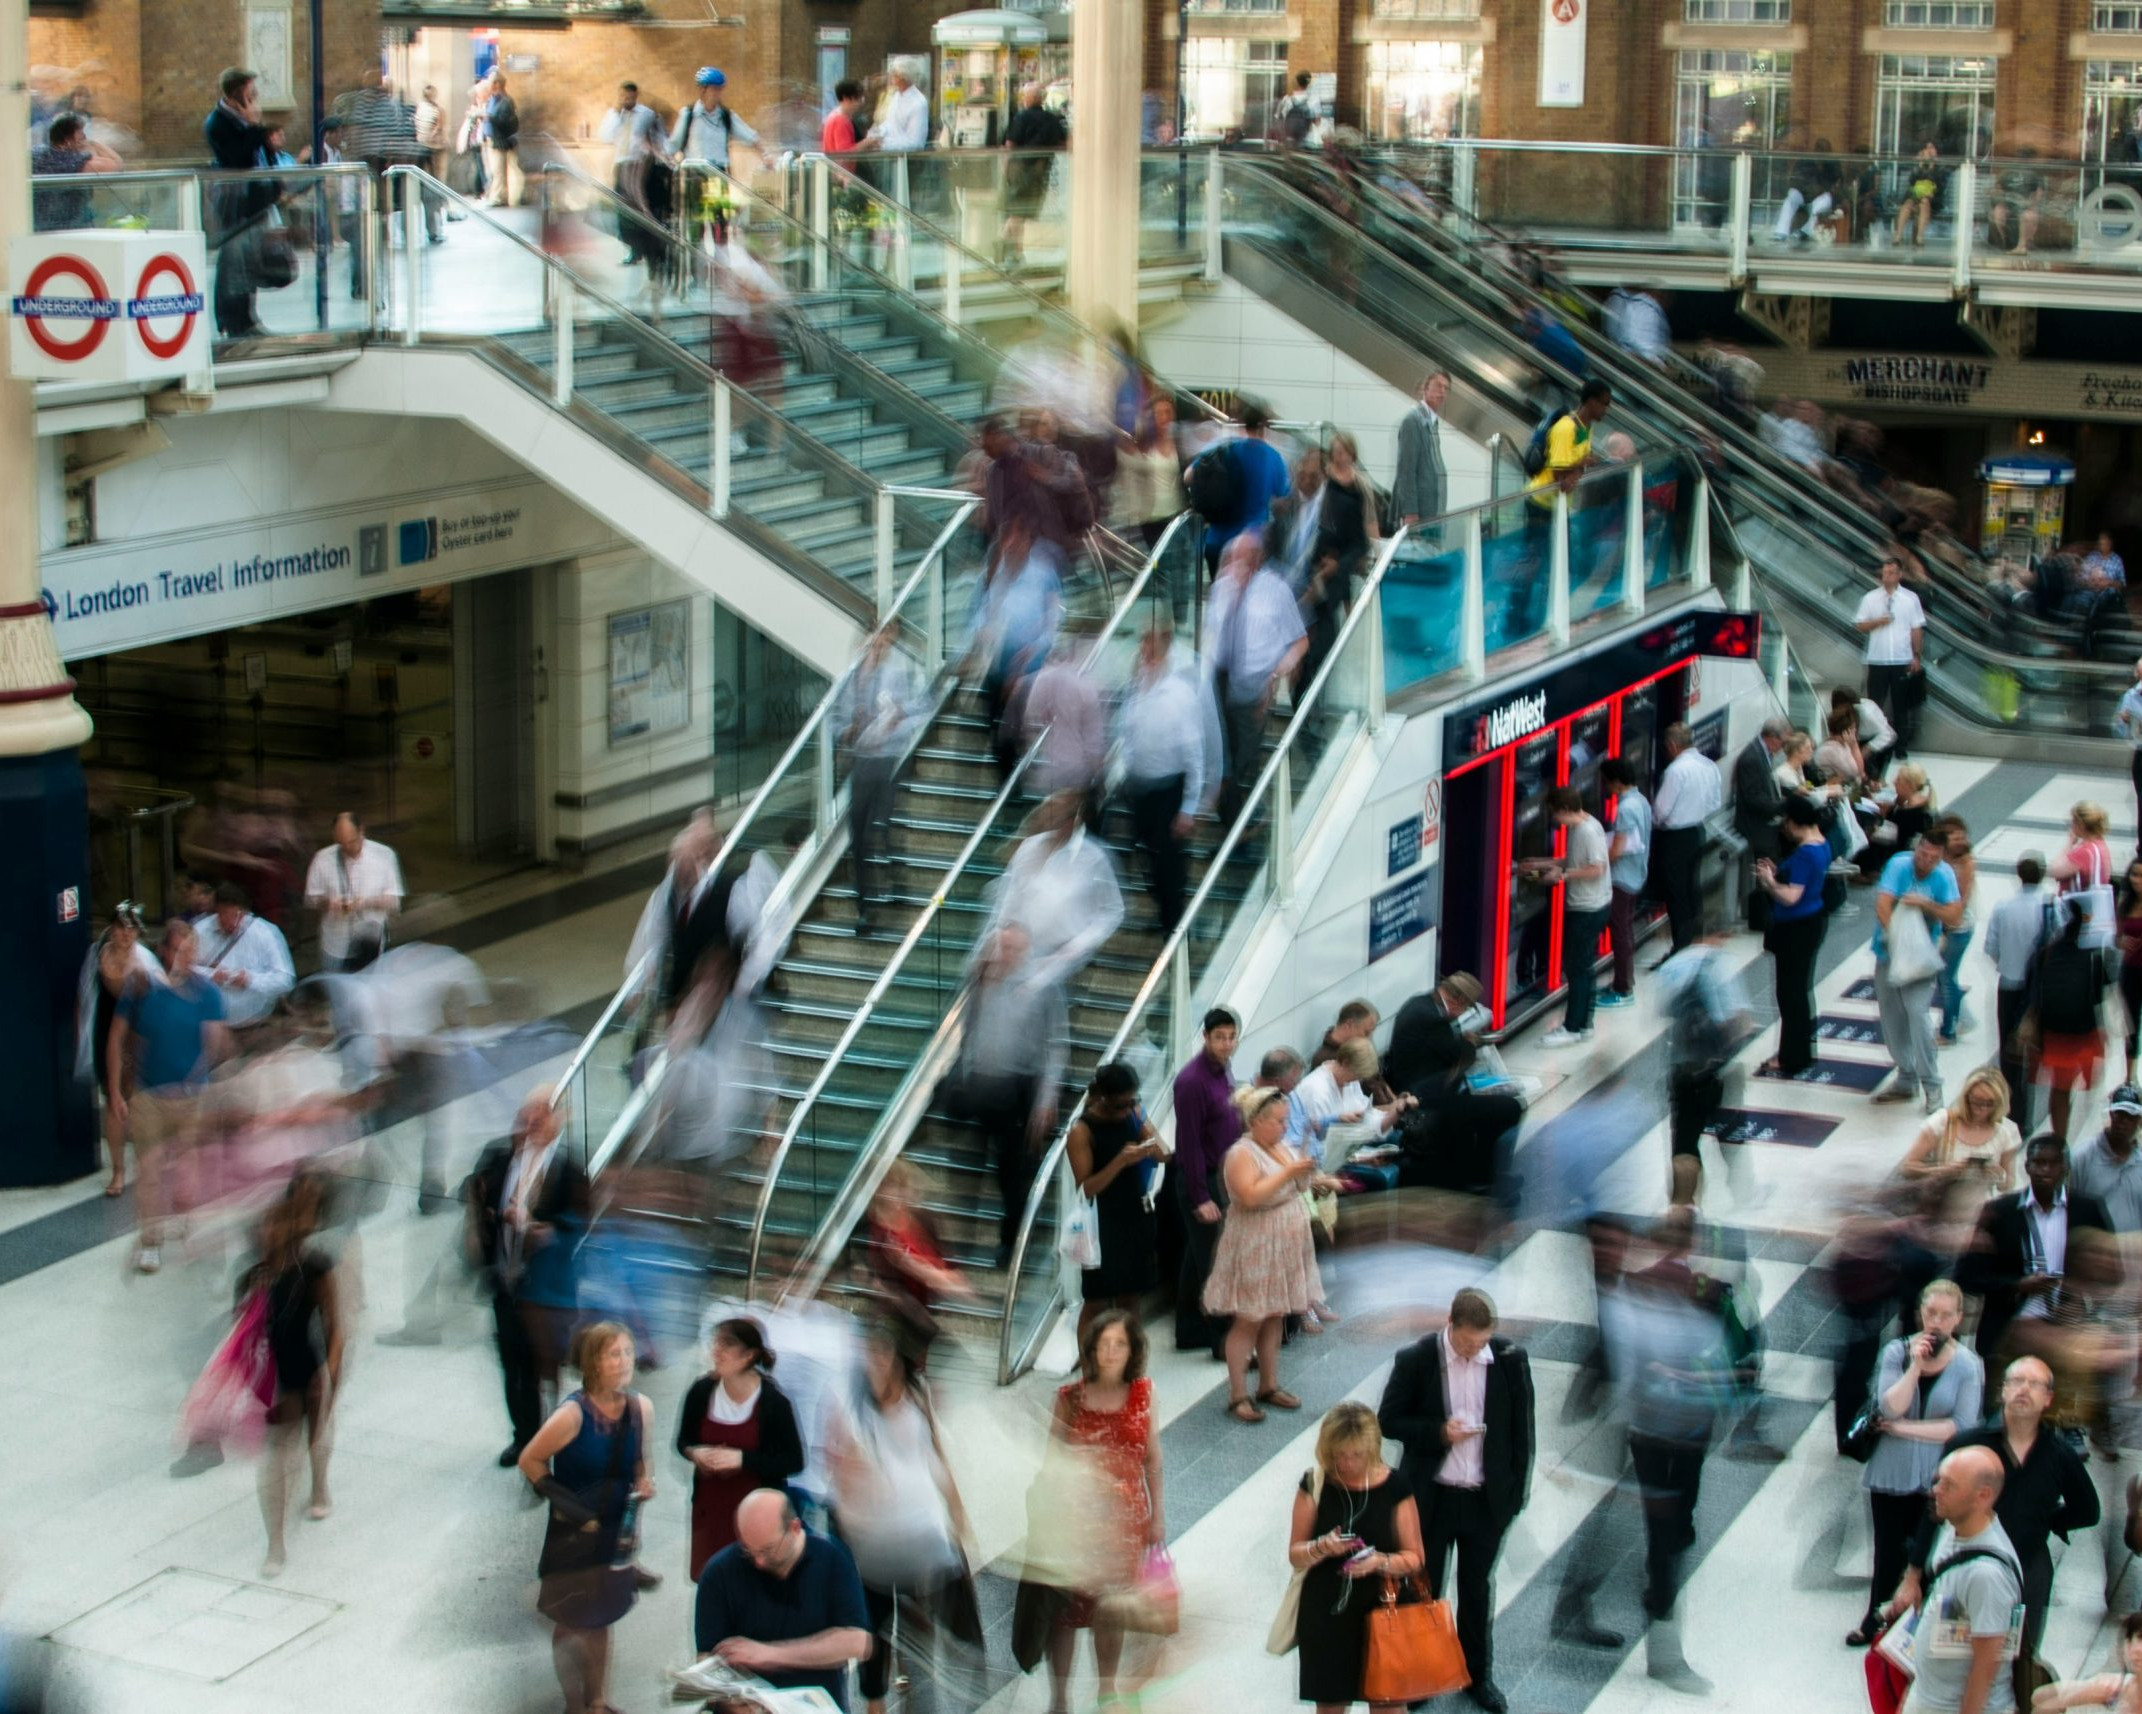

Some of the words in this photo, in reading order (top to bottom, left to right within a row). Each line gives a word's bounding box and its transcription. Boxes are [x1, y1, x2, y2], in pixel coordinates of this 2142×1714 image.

[19, 300, 115, 315] UNDERGROUND
[132, 296, 200, 314] UNDERGROUND
[1847, 356, 1992, 388] MERCHANT
[1866, 384, 1970, 403] BISHOPSGATE
[66, 580, 149, 621] London
[158, 564, 223, 600] Travel
[233, 543, 351, 588] Information
[1491, 688, 1547, 750] NatWest
